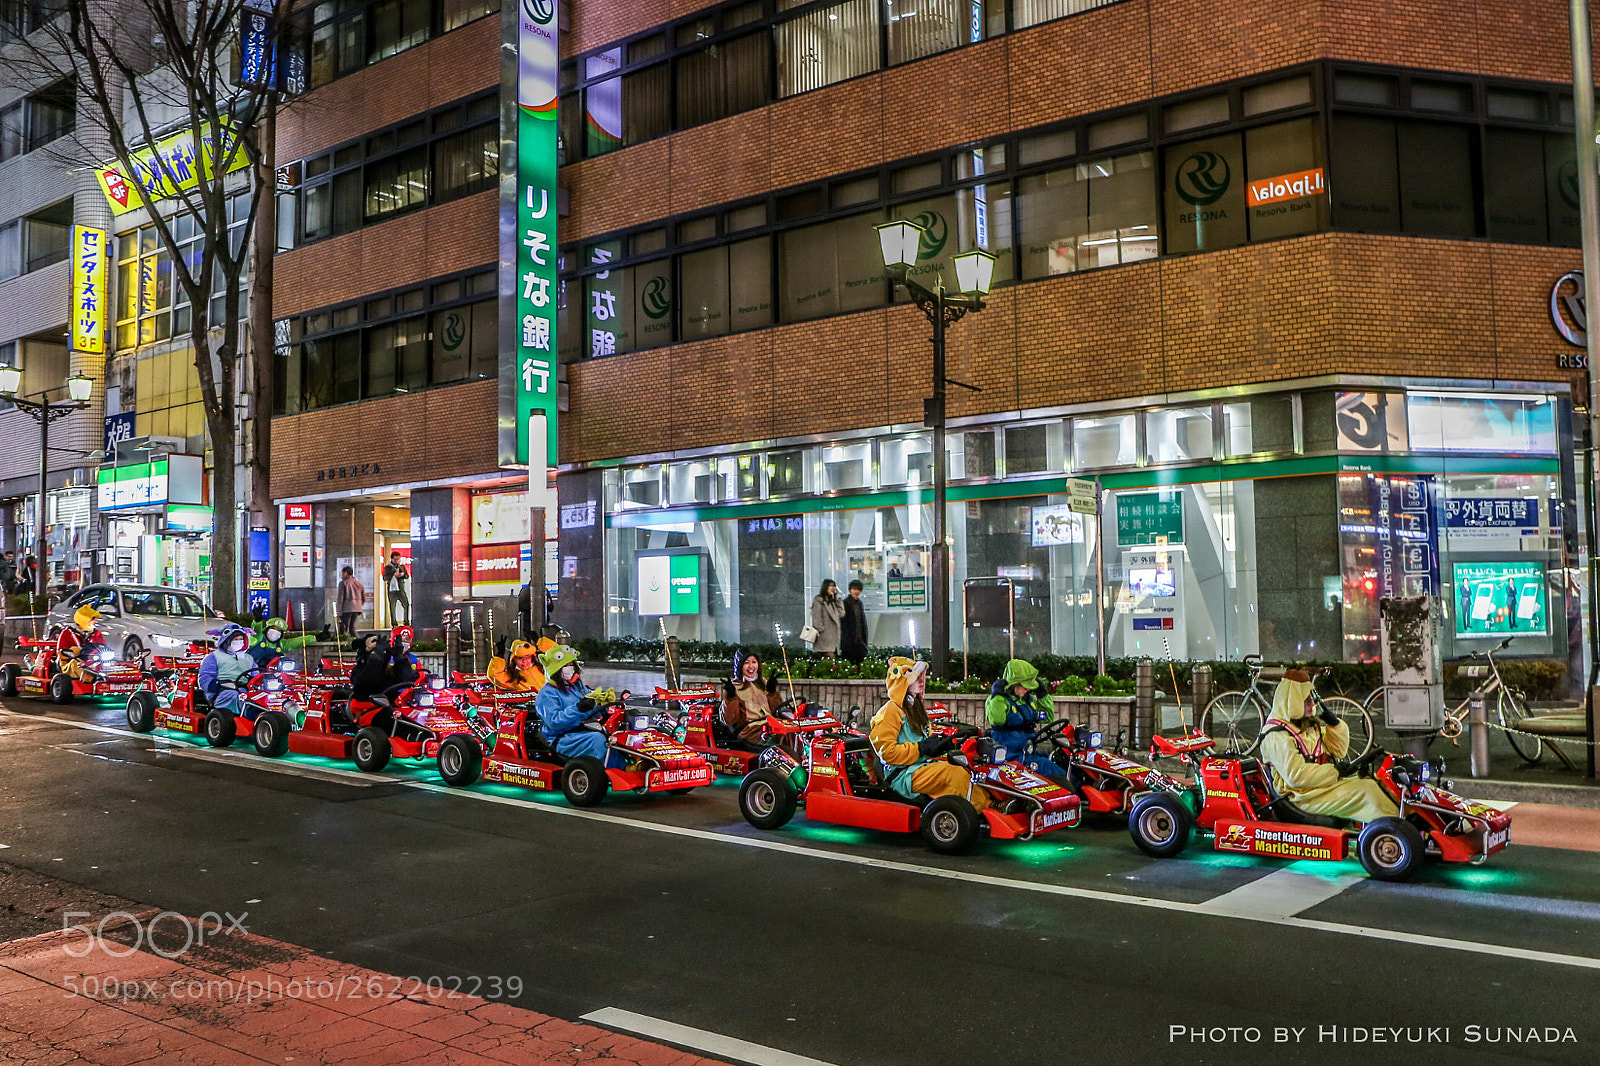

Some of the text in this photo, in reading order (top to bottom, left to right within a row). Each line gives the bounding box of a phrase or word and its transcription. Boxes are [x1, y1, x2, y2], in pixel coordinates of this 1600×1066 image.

[524, 22, 551, 39] RESONA
[112, 186, 126, 198] 3F
[1179, 209, 1228, 224] RESONA
[1256, 201, 1312, 218] Resona Bank
[908, 262, 945, 276] RESONA
[80, 230, 99, 334] センタースポーツ
[522, 184, 551, 394] りそな銀行
[845, 278, 868, 288] Resona
[79, 335, 97, 349] 3F
[1119, 502, 1181, 518] 相続相談会
[1379, 479, 1391, 541] Exchange
[1462, 500, 1528, 519] 外貨両替
[475, 557, 518, 571] 三井のリハウス
[502, 772, 545, 789] MariCar.com
[663, 769, 707, 783] MariCar.com
[1206, 789, 1239, 798] MariCar.com
[1042, 809, 1076, 828] MariCar.com
[1254, 828, 1322, 846] Street Kart Tour
[1254, 839, 1331, 860] MariCar.com
